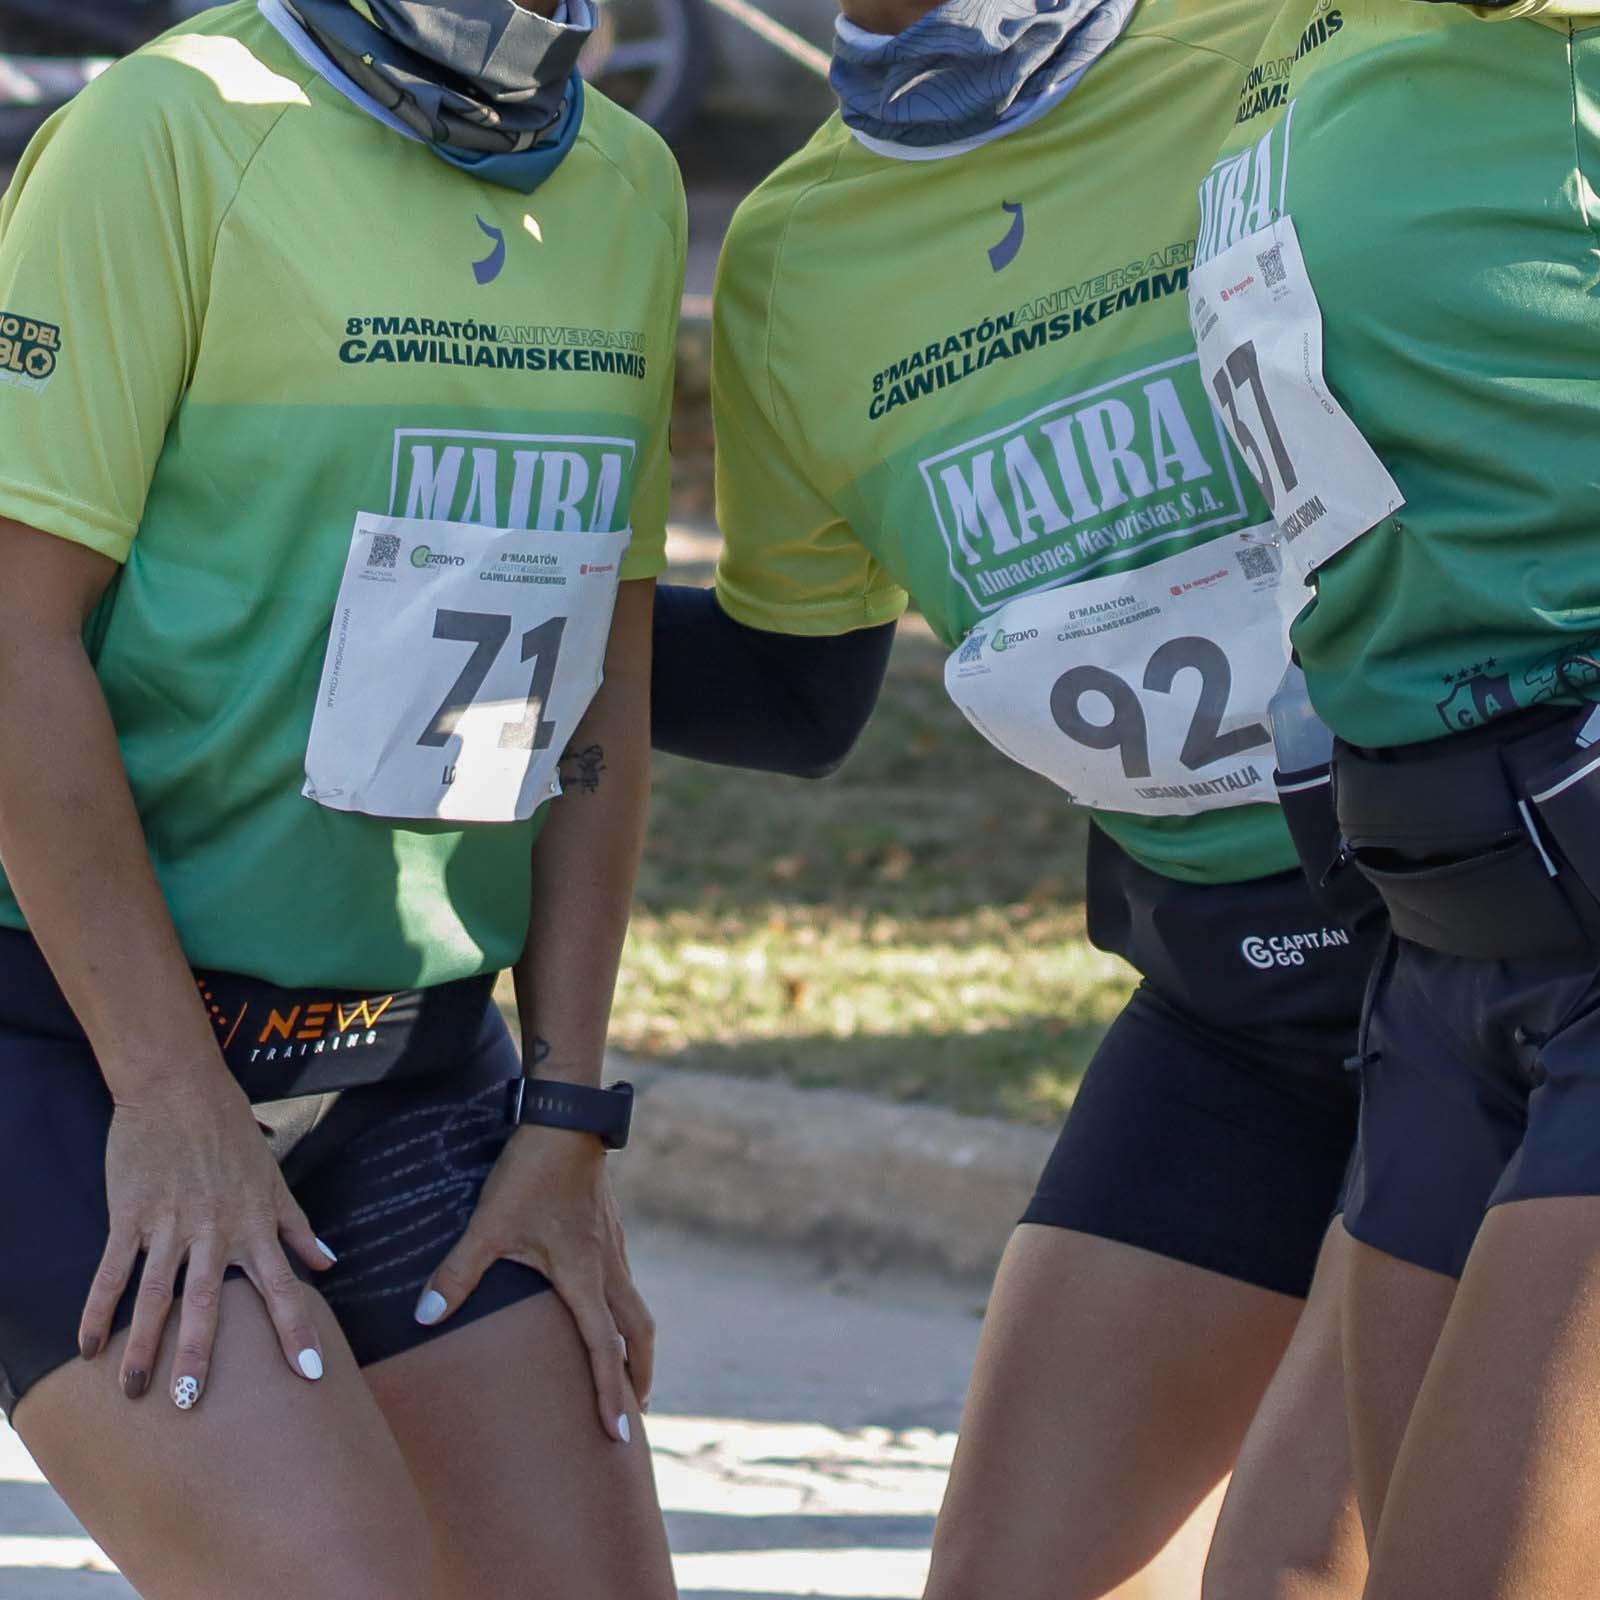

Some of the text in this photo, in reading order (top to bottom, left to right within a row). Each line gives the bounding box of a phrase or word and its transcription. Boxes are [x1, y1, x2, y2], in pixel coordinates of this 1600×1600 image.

[1012, 239, 1197, 326] ANIVERSARI
[22, 321, 58, 348] DEL
[339, 339, 646, 379] CAWILLIAMSKEMMIS
[869, 265, 1194, 420] CAWILLIAMSKEMM
[404, 445, 622, 533] MAIRA
[940, 378, 1213, 566] MAIRA
[976, 487, 1225, 597] Almacenes Mayoristas S.A.
[416, 608, 568, 750] 71
[1050, 636, 1272, 778] 92
[1268, 927, 1350, 952] CAPITÁN
[1275, 951, 1305, 966] GO
[251, 1030, 377, 1063] TRAINING
[258, 996, 393, 1043] NEW
